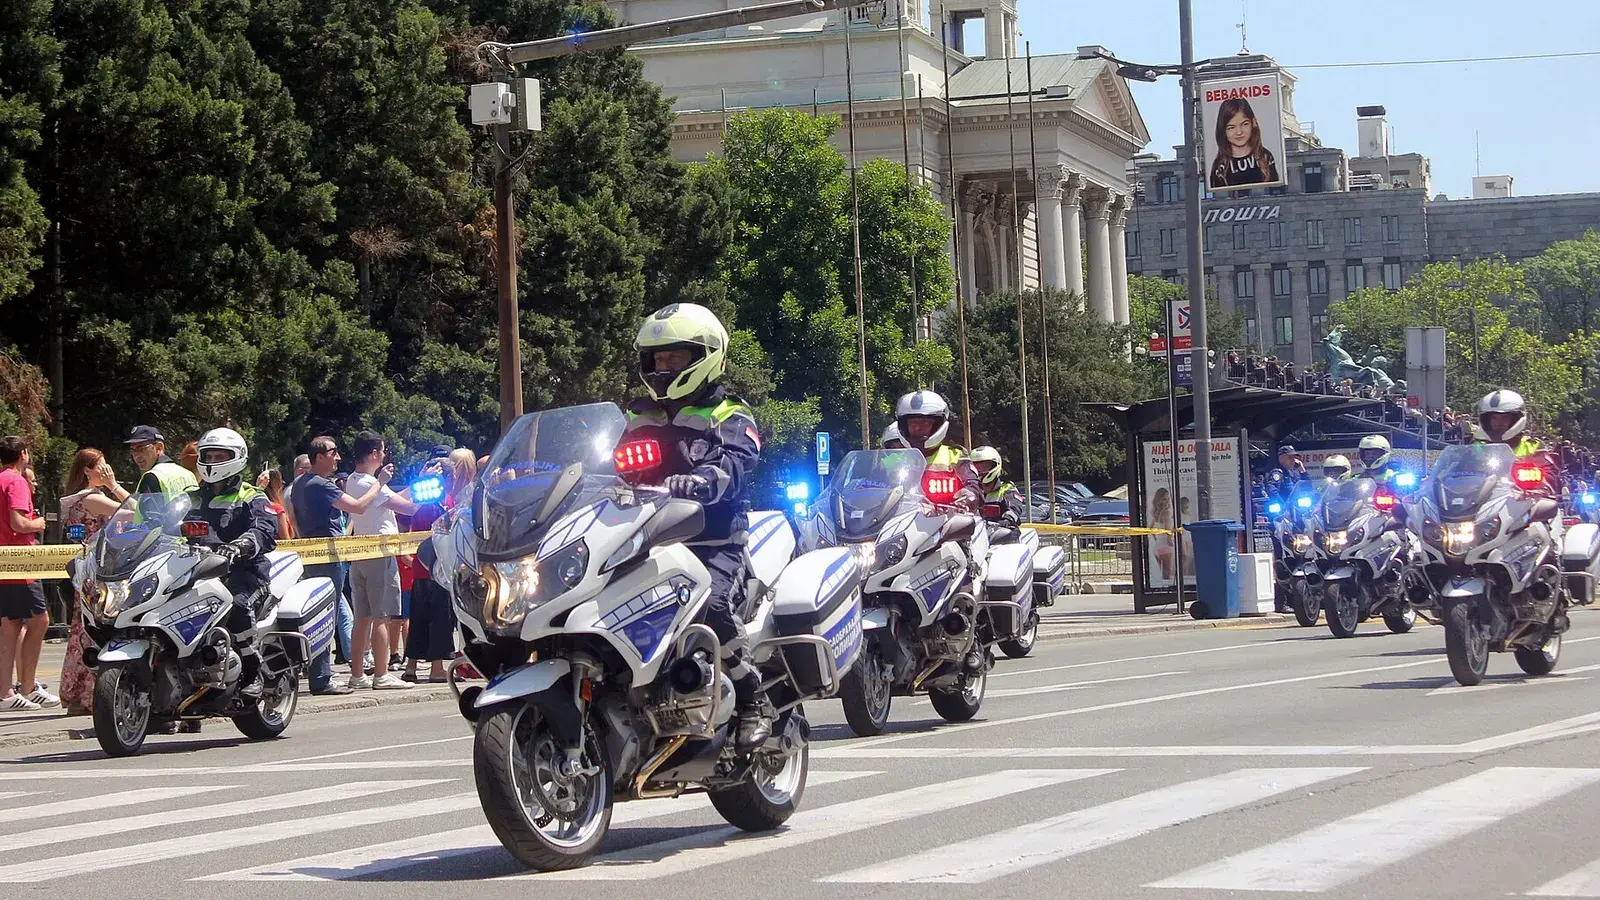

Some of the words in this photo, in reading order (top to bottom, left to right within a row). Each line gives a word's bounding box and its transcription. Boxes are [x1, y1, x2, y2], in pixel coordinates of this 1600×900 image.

[1205, 84, 1271, 102] BEBAKIDS
[1203, 205, 1281, 223] ПОШТА
[819, 436, 827, 459] P
[1151, 445, 1170, 455] NIJE
